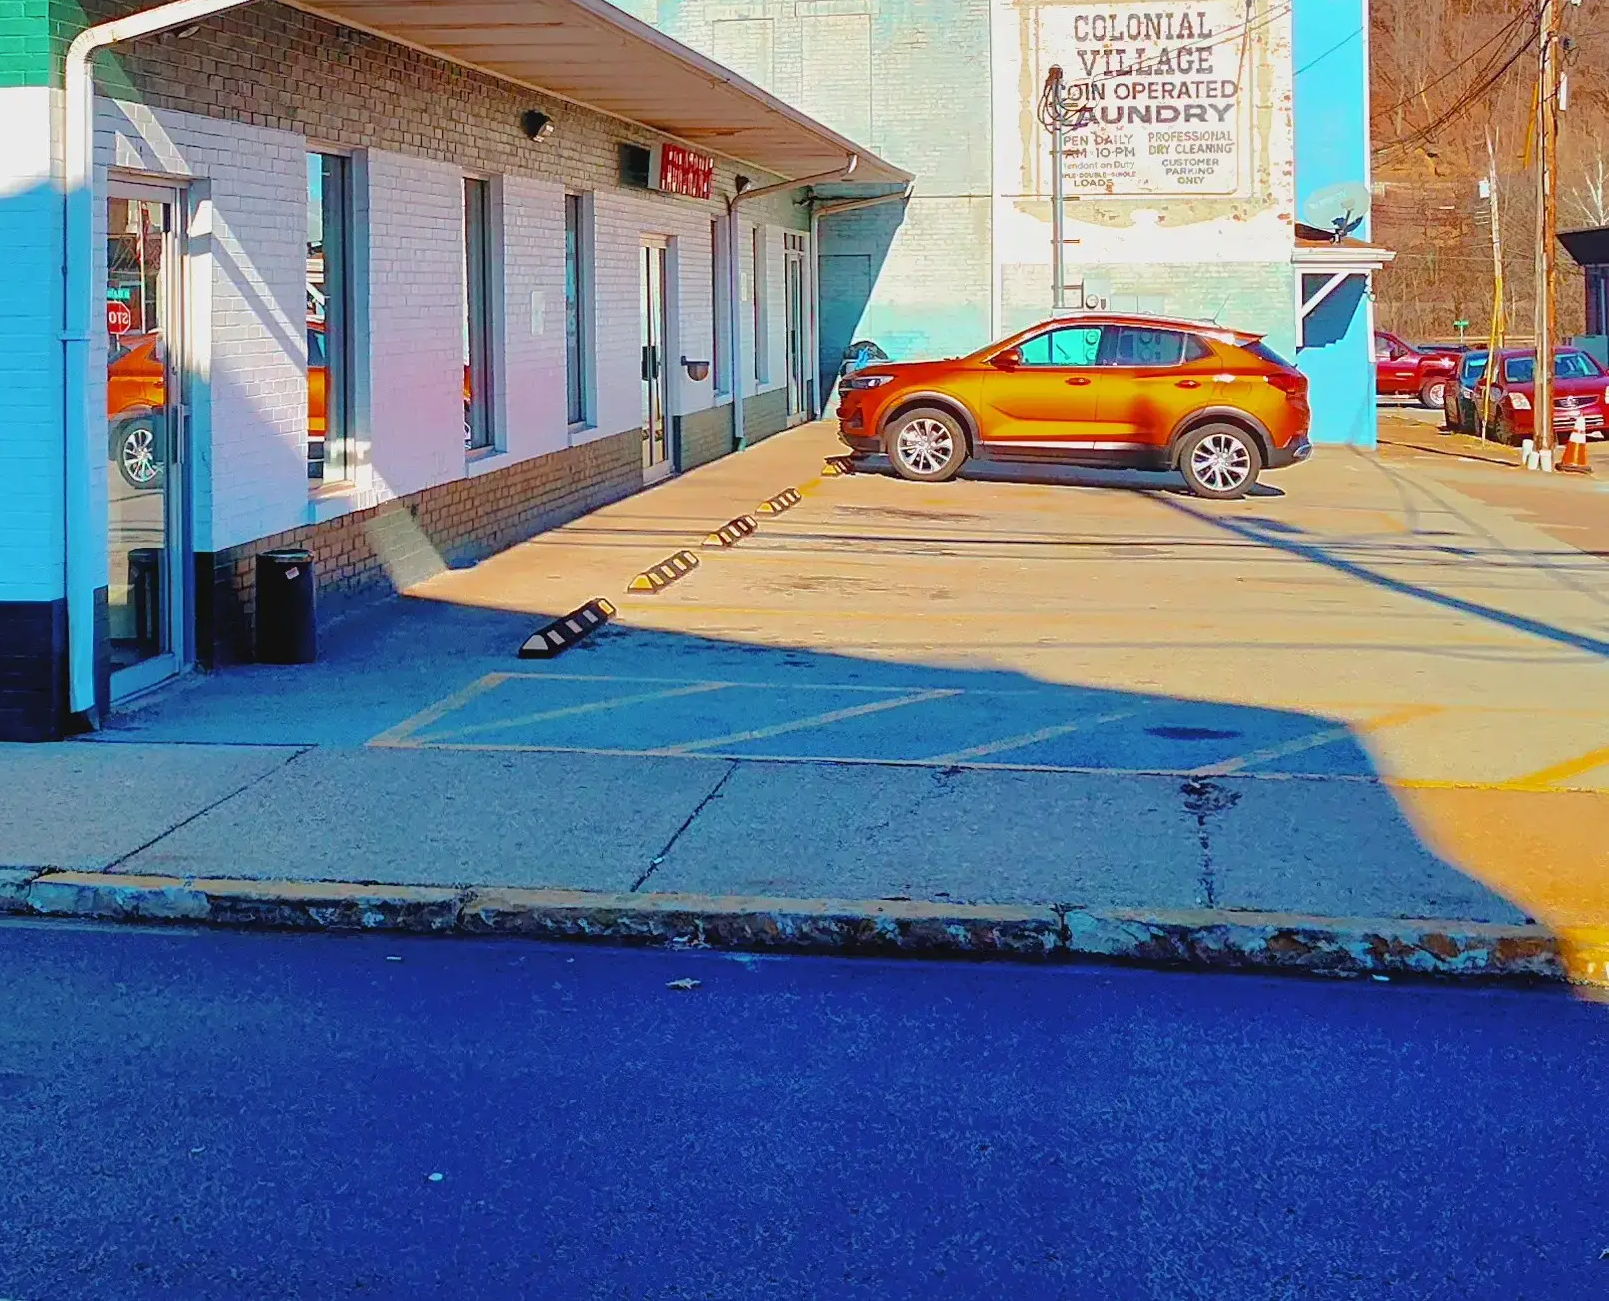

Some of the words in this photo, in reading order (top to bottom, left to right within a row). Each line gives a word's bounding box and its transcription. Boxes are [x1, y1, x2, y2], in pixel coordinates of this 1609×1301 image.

[1074, 12, 1212, 42] COLONIAL
[1077, 48, 1213, 76] VILLAGE
[1114, 80, 1238, 99] OPERATED
[1063, 135, 1088, 146] PEN
[1094, 134, 1133, 146] DAILY
[1148, 131, 1233, 142] PROFESSIONAL
[1148, 144, 1170, 155] DRY
[1175, 142, 1235, 154] CLEANING
[1162, 158, 1219, 167] CUSTOMER
[1166, 167, 1214, 175] PARKING
[1074, 179, 1114, 188] LOADS
[1177, 176, 1205, 184] ONLY
